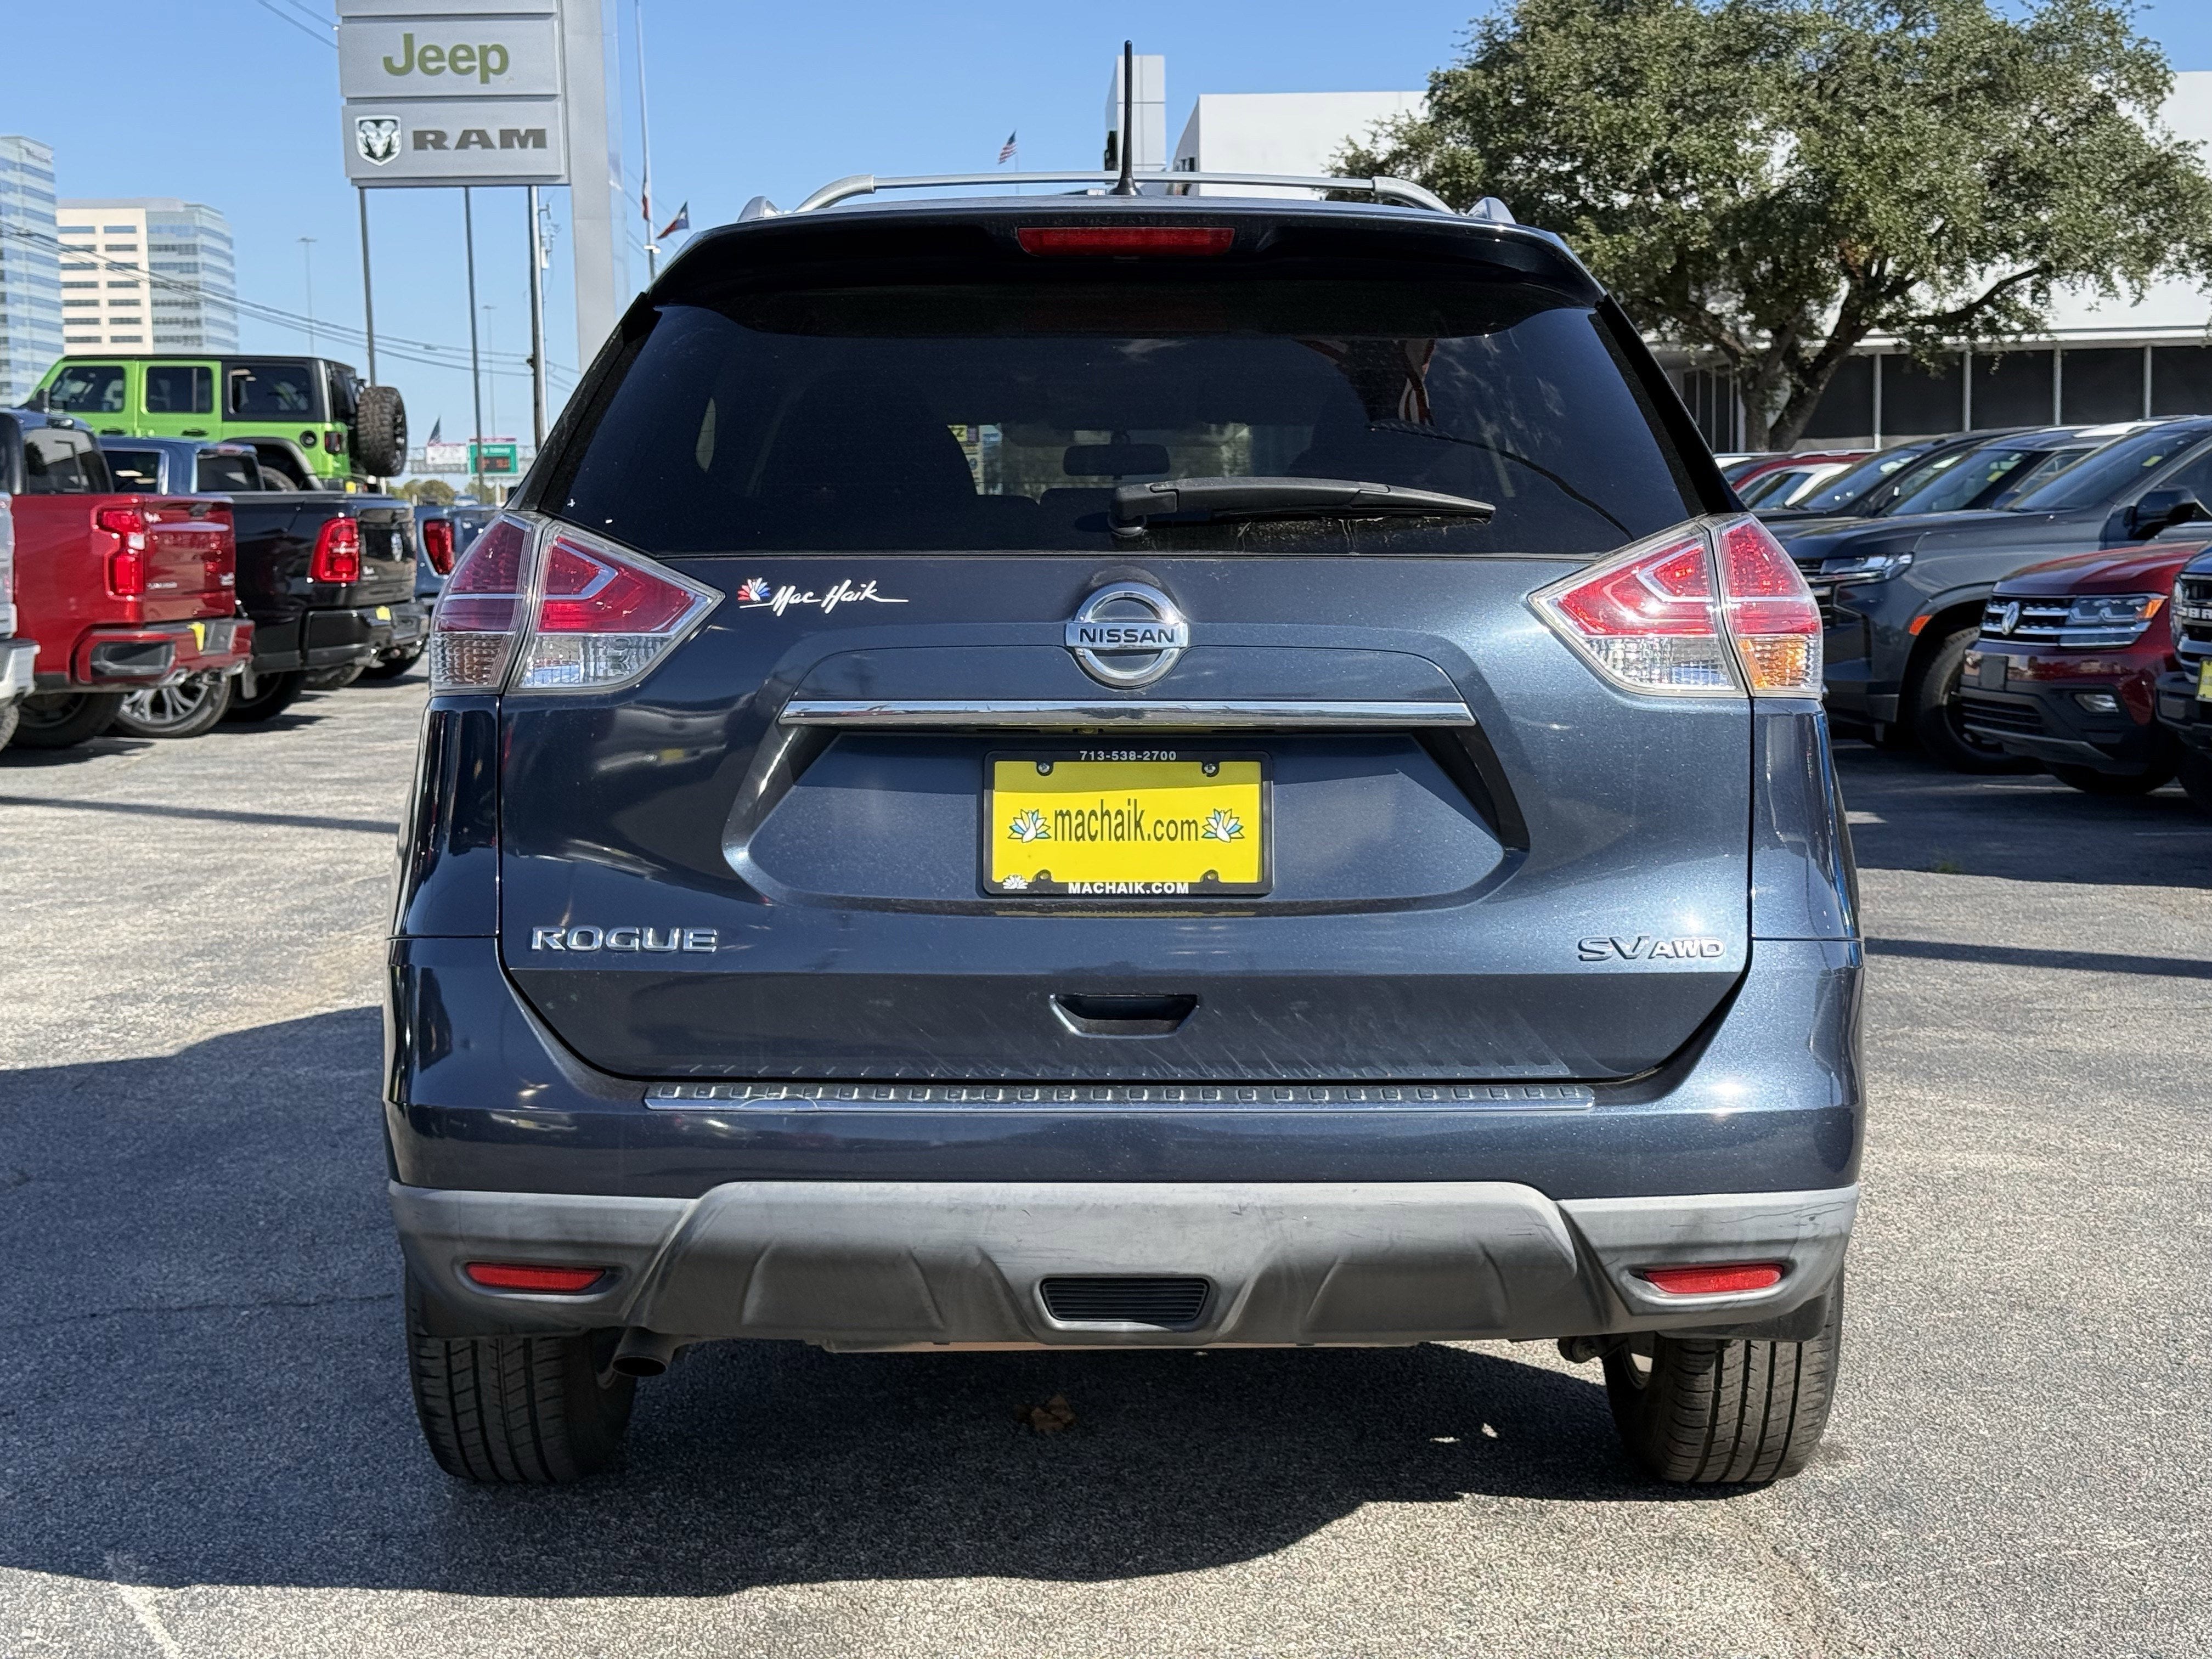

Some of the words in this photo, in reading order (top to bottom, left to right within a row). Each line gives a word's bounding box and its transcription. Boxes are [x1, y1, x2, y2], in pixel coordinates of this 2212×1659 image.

[383, 33, 509, 84] Jeep
[413, 128, 547, 150] RAM
[740, 585, 822, 616] Mac
[821, 579, 909, 613] Haik
[1080, 628, 1175, 643] NISSAN
[1080, 751, 1177, 761] 713-538-2700
[1054, 799, 1198, 842] machaik.com
[1068, 882, 1189, 894] MACHAIK.COM
[531, 926, 718, 952] ROGUE
